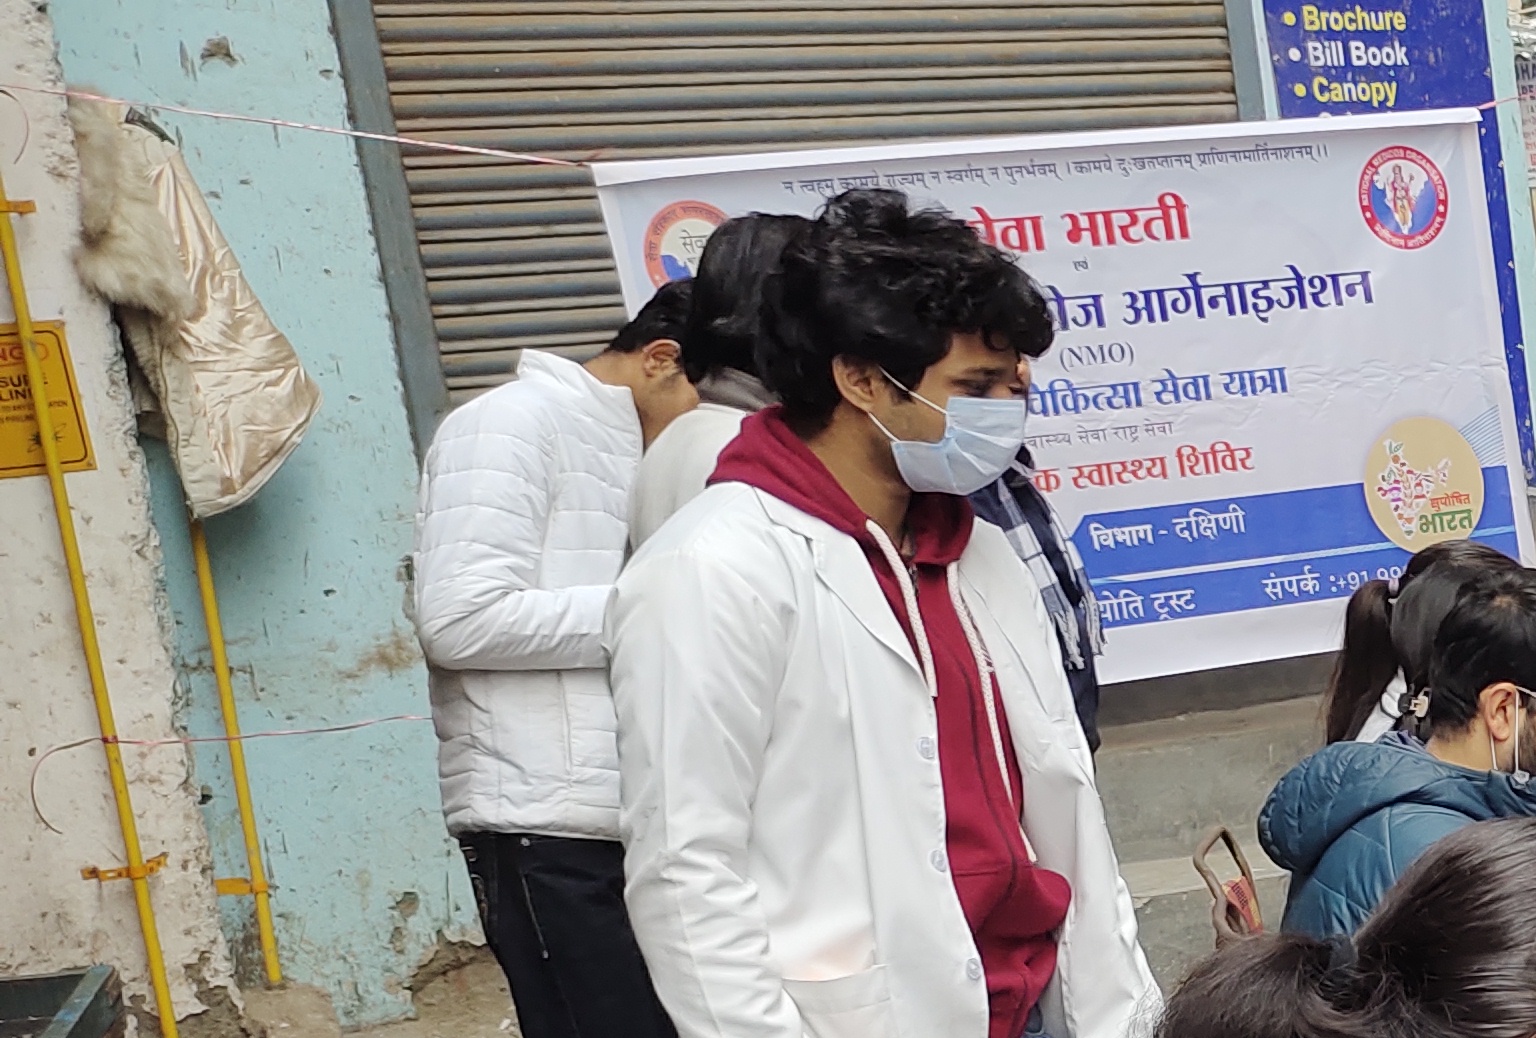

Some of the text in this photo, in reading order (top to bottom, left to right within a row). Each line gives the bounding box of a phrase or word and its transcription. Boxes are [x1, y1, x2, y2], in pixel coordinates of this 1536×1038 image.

[1302, 4, 1407, 31] Brochure
[1307, 40, 1409, 67] Bill Book
[1313, 75, 1397, 108] Canopy
[781, 180, 796, 195] न
[929, 170, 942, 185] न
[988, 166, 1001, 182] न
[1061, 192, 1191, 247] भारती
[1122, 264, 1374, 324] आर्गेनाइजेशन
[1059, 341, 1135, 373] (NMO)
[1151, 368, 1213, 405] सेवा
[1219, 366, 1289, 398] यात्रा
[1077, 424, 1109, 444] सेवा
[1111, 424, 1140, 443] राष्ट्र
[1144, 418, 1174, 437] सेवा
[1068, 456, 1170, 490] स्वास्थ्य
[1175, 440, 1256, 479] शिविर
[1089, 522, 1155, 552] विभाग
[1171, 503, 1246, 543] दक्षिणी
[1418, 508, 1473, 534] भारत
[1098, 588, 1145, 622] योति
[1150, 589, 1197, 621] ट्रस्ट
[1261, 564, 1321, 600] संपर्क
